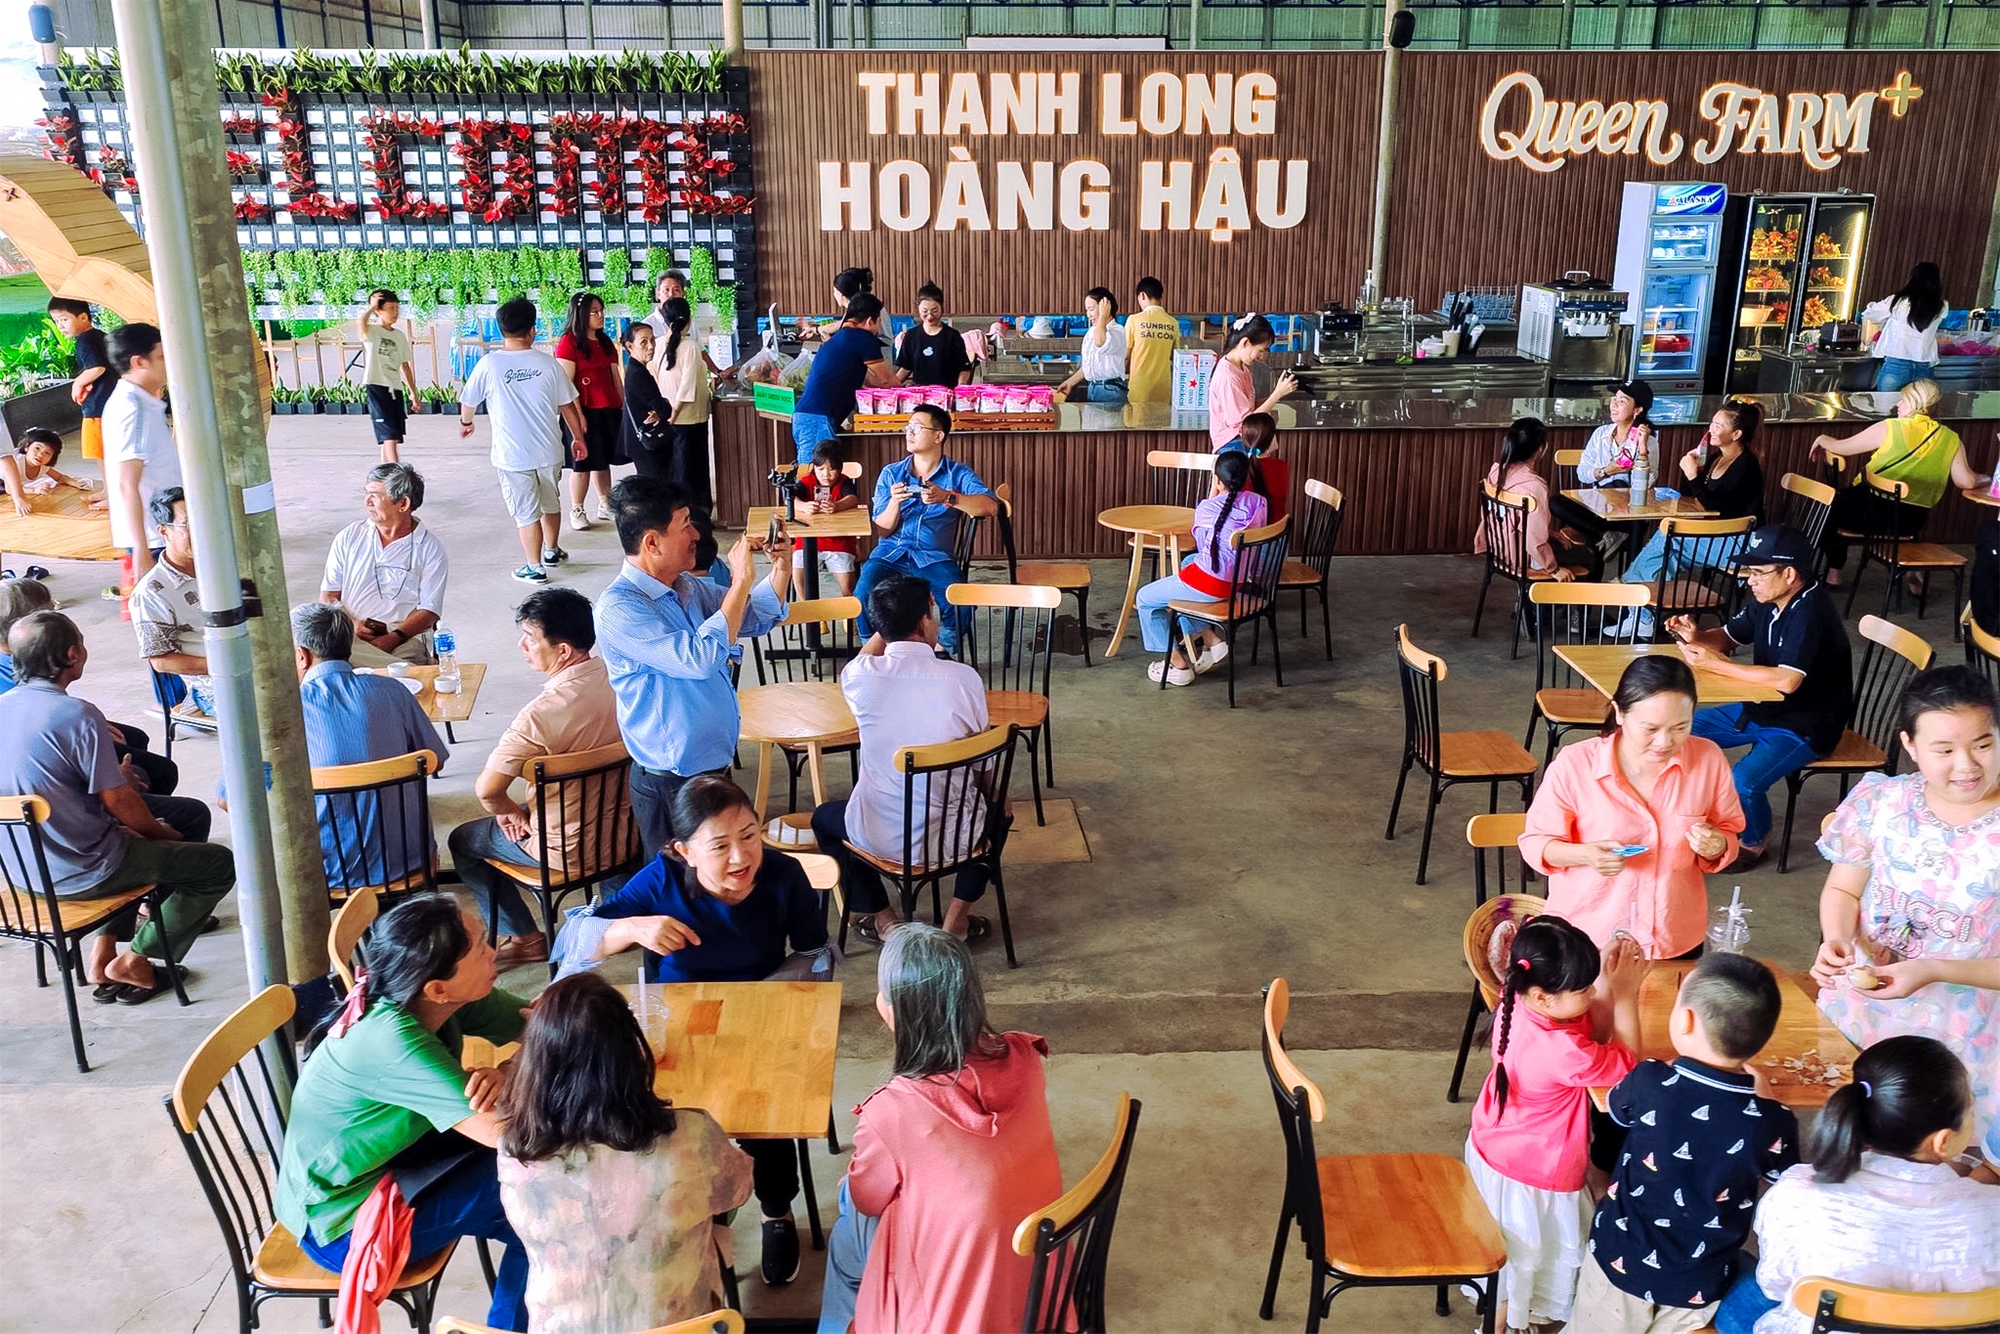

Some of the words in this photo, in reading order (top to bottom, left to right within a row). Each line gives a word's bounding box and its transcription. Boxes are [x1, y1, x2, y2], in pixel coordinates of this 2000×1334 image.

[859, 72, 1080, 134] THANH
[1102, 72, 1277, 135] LONG
[1481, 71, 1684, 172] Queen
[819, 146, 1111, 232] HOÀNG
[1141, 147, 1308, 241] HẬU
[1179, 372, 1187, 406] Heineken
[1198, 372, 1206, 406] Heineken
